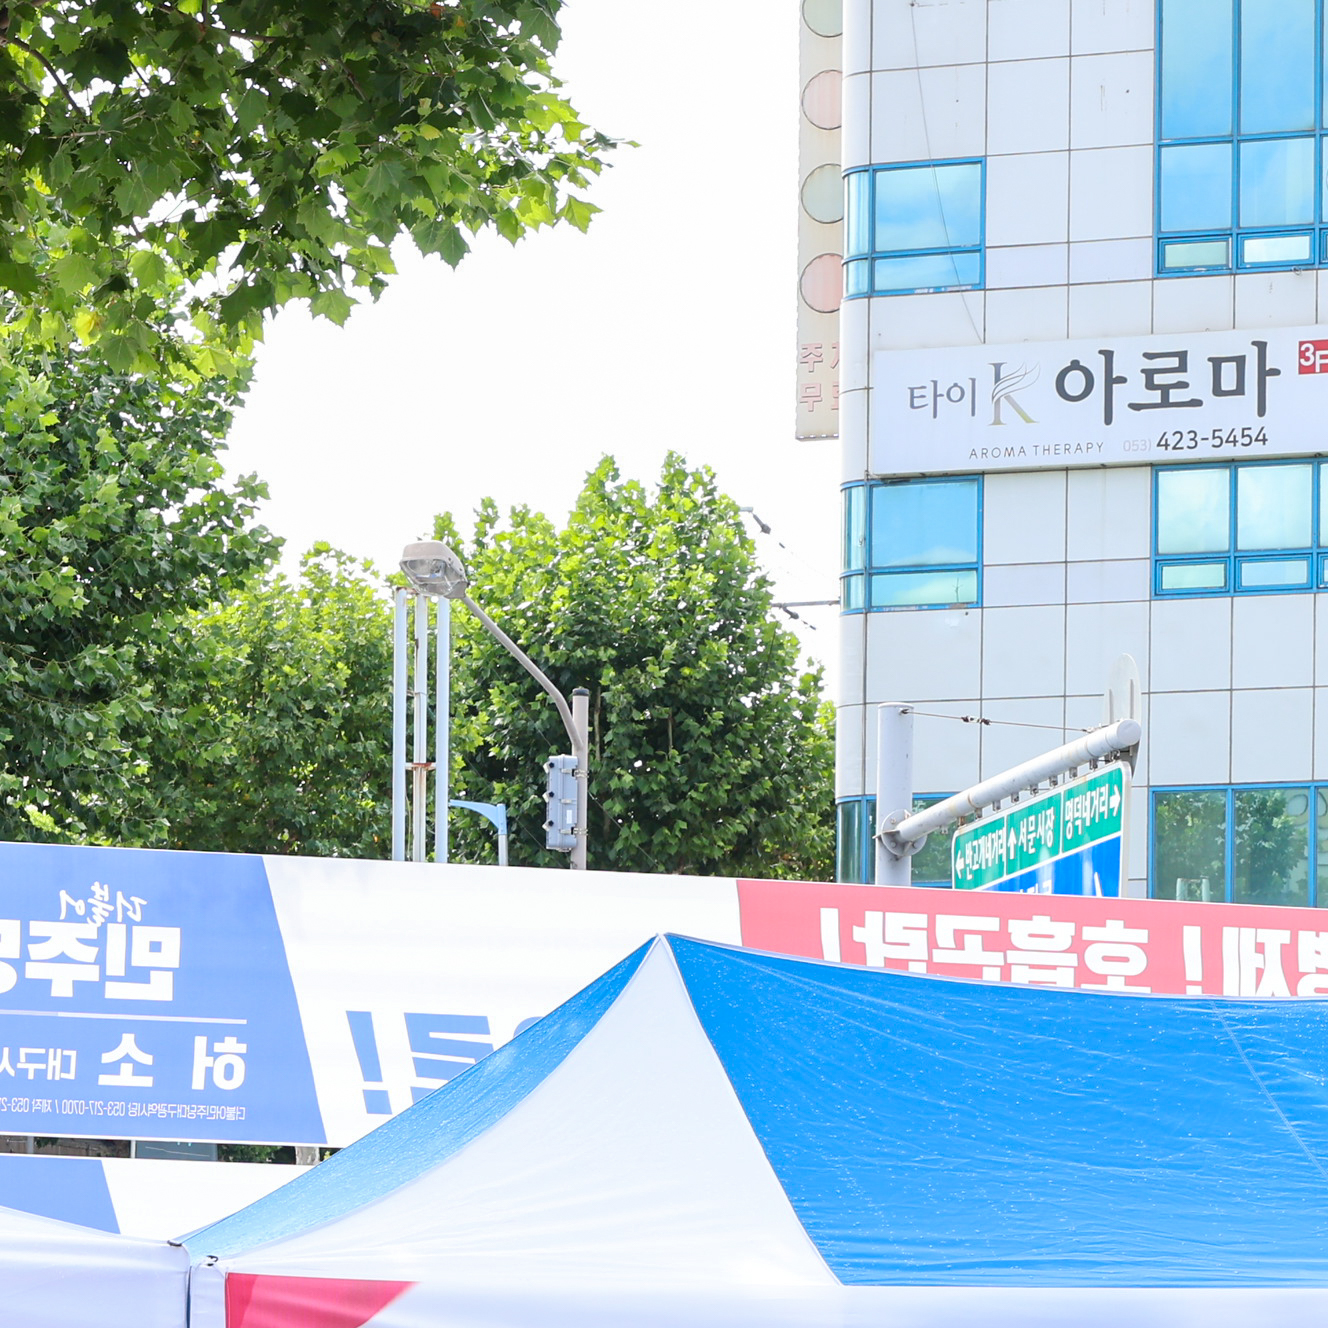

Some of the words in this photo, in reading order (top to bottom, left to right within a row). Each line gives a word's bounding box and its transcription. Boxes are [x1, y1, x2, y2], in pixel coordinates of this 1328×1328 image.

[907, 376, 977, 420] 타이
[1055, 339, 1282, 426] 아로마
[968, 444, 1027, 460] AROMA
[1033, 441, 1105, 457] THERAPY
[1155, 425, 1269, 452] 423-5454
[965, 826, 1006, 881] 반고개네거리
[1018, 806, 1055, 855] 서문시장
[1065, 782, 1110, 841] 명덕네거리
